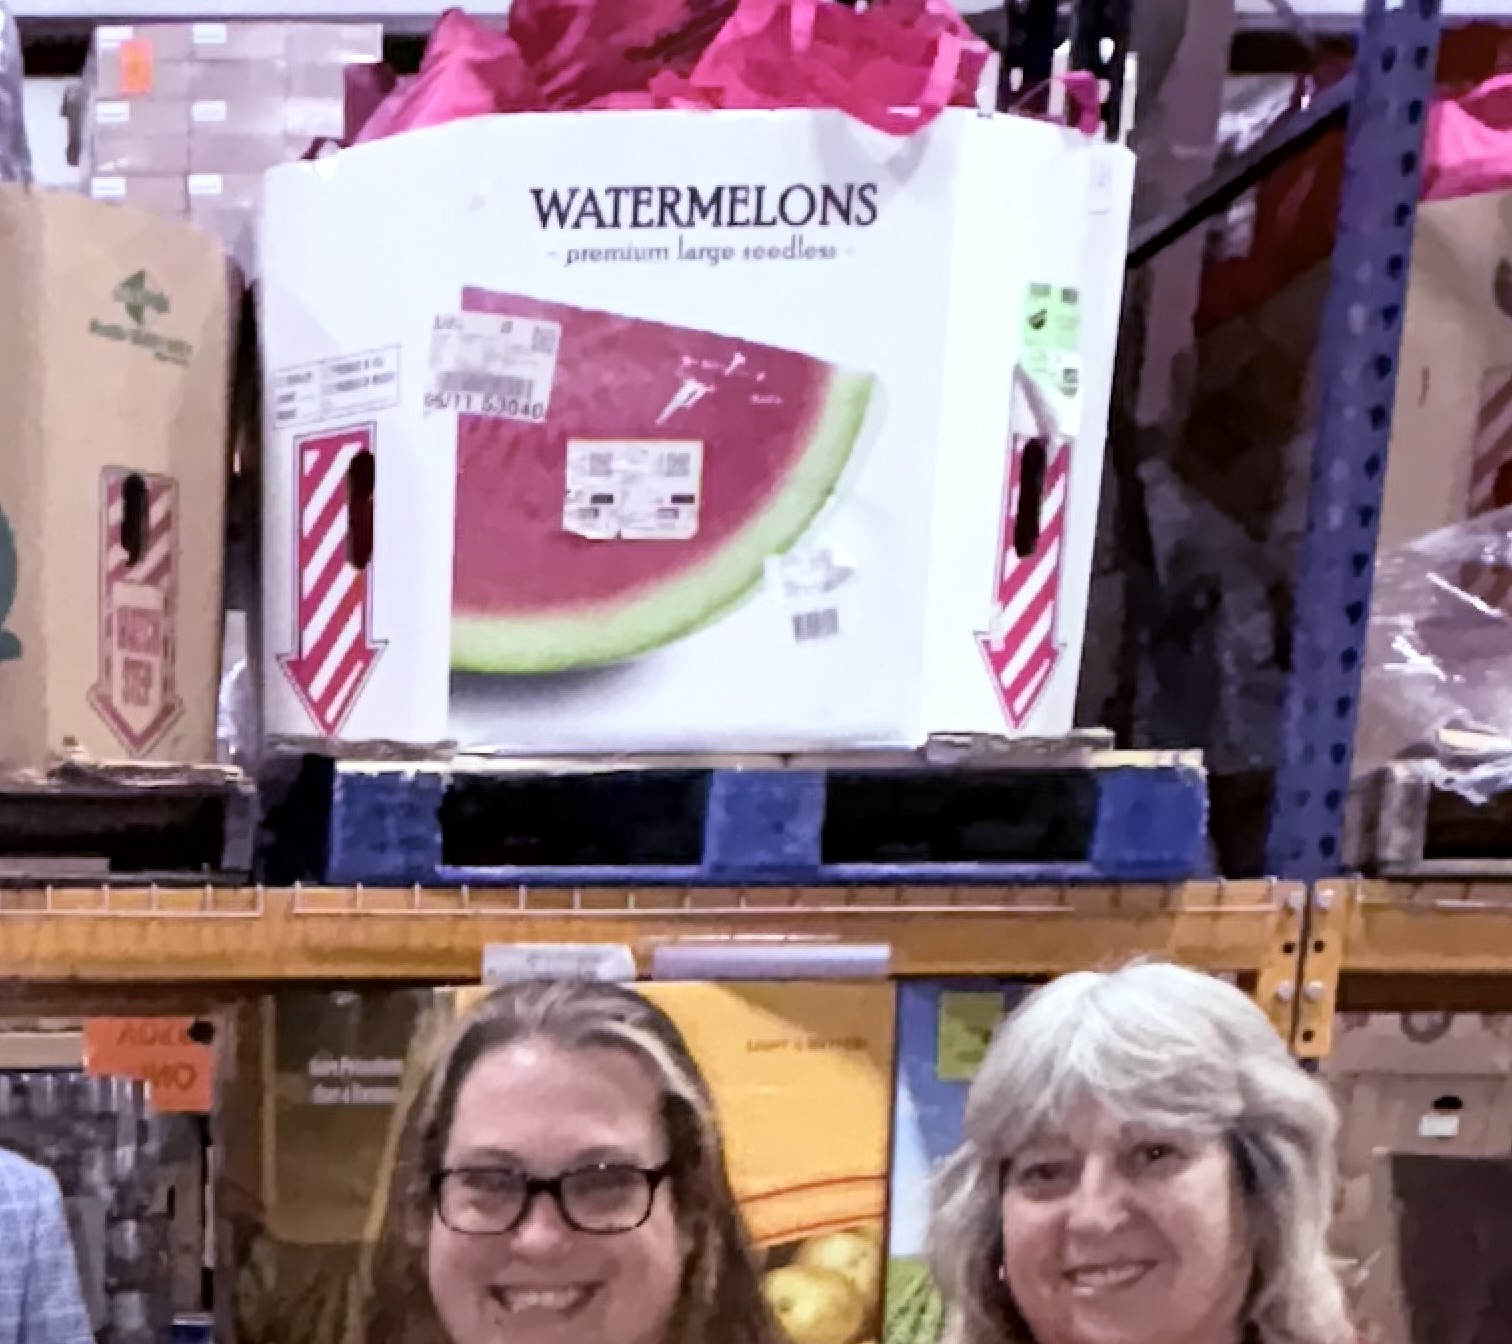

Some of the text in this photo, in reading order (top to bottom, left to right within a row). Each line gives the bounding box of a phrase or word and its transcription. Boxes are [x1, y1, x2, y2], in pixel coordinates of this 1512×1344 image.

[529, 183, 878, 230] WATERMELONS
[565, 233, 837, 267] premium large seedless
